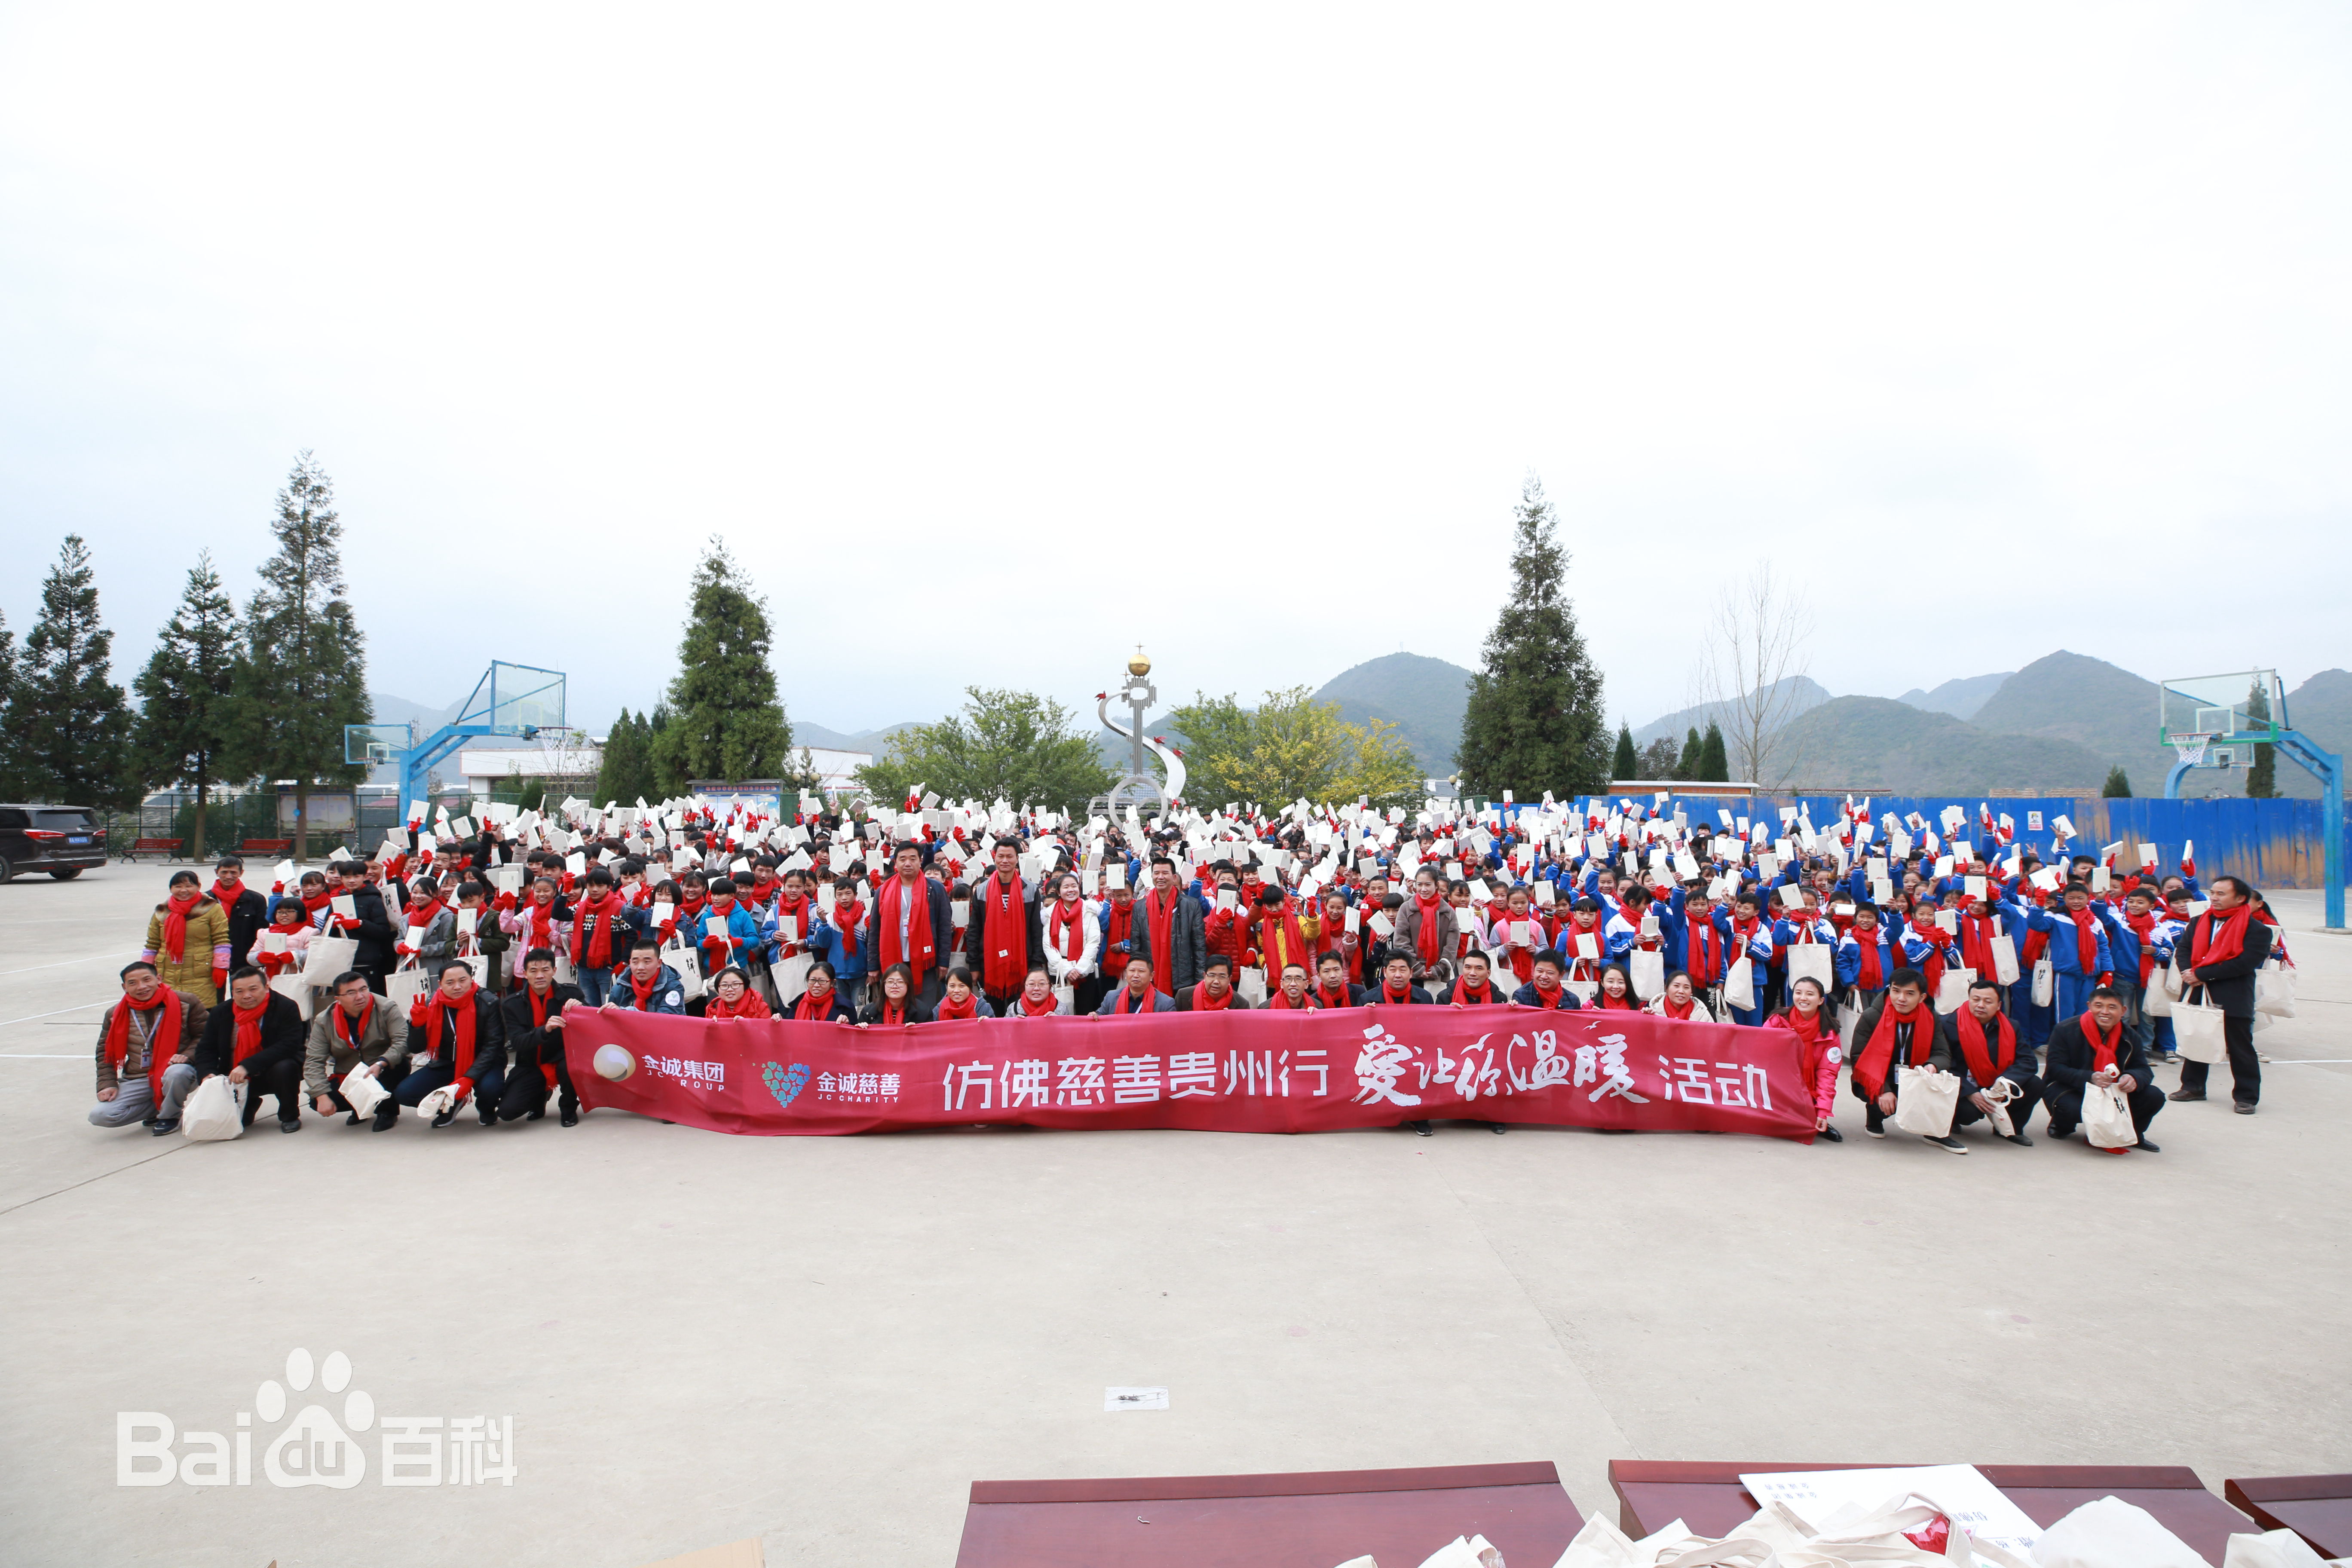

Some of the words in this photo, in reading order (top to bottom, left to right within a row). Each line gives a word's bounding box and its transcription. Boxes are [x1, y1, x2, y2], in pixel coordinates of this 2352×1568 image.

[642, 1055, 724, 1083] 金诚集团
[647, 1069, 664, 1078] JC
[672, 1078, 725, 1092] ROUP
[817, 1071, 900, 1095] 金诚慈善
[1659, 1054, 1774, 1111] 活动
[839, 1095, 898, 1103] CHARITY
